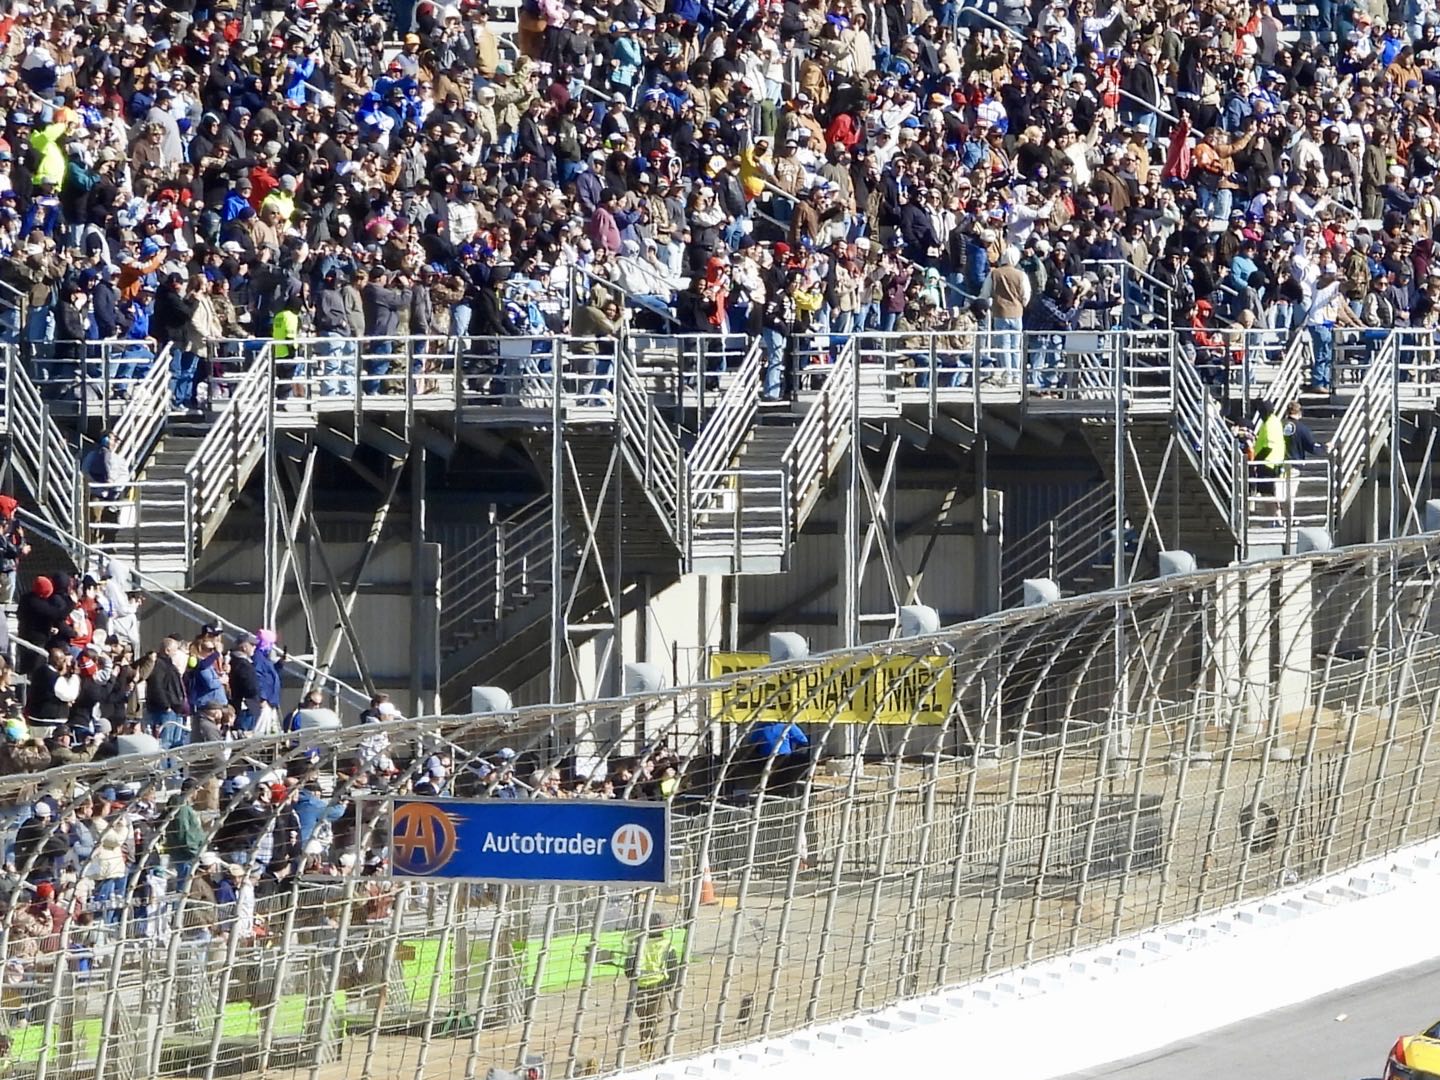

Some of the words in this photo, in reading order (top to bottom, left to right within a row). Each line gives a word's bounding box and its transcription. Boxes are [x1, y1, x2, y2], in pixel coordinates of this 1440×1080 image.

[720, 665, 854, 711] PEDESTRIAN
[863, 666, 943, 713] TUNNEL
[482, 832, 606, 855] Autotrader
